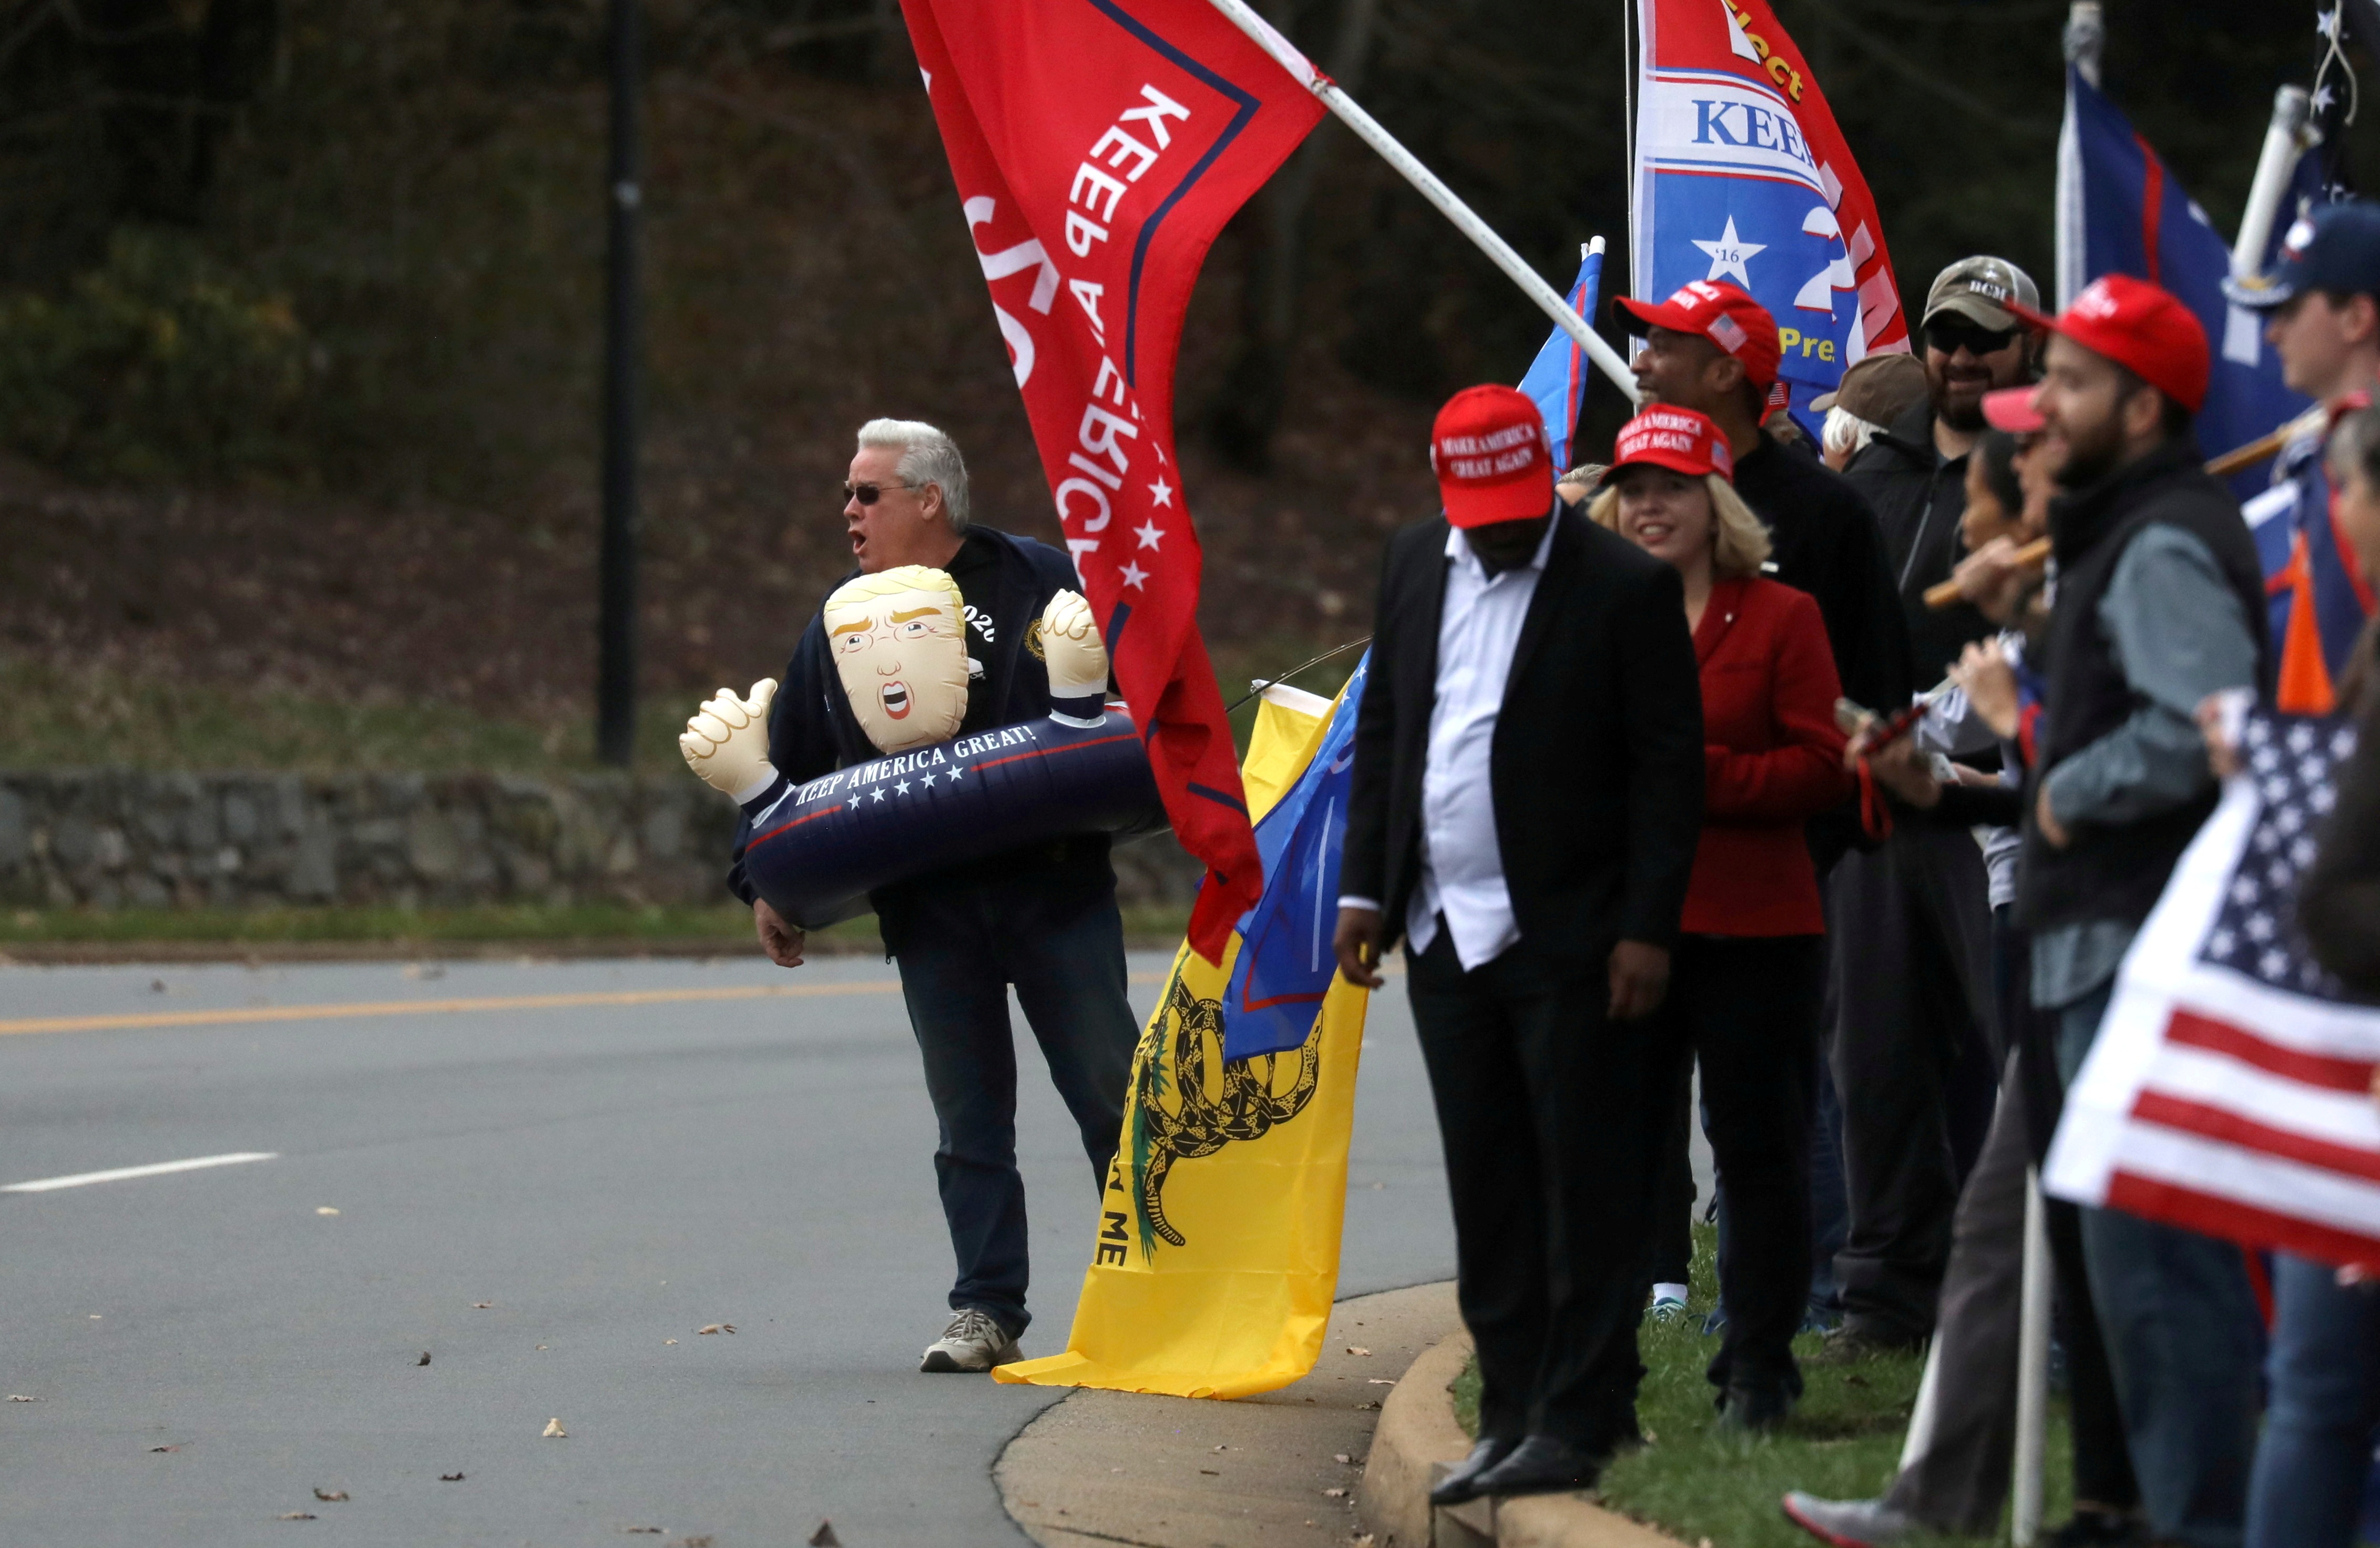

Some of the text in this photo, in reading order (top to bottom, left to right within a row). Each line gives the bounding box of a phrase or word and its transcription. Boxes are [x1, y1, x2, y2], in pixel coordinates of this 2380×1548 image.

[1691, 99, 1815, 170] KEE
[1779, 327, 1835, 363] Pre
[1441, 423, 1536, 456] MAKE AMERICA
[1644, 412, 1702, 437] AMERICA
[1650, 431, 1693, 453] AGAIN
[1450, 447, 1534, 478] GREAT AGAIN
[795, 725, 1037, 807] KEEP AMERICA GREAT!
[1096, 1210, 1129, 1266] ME
